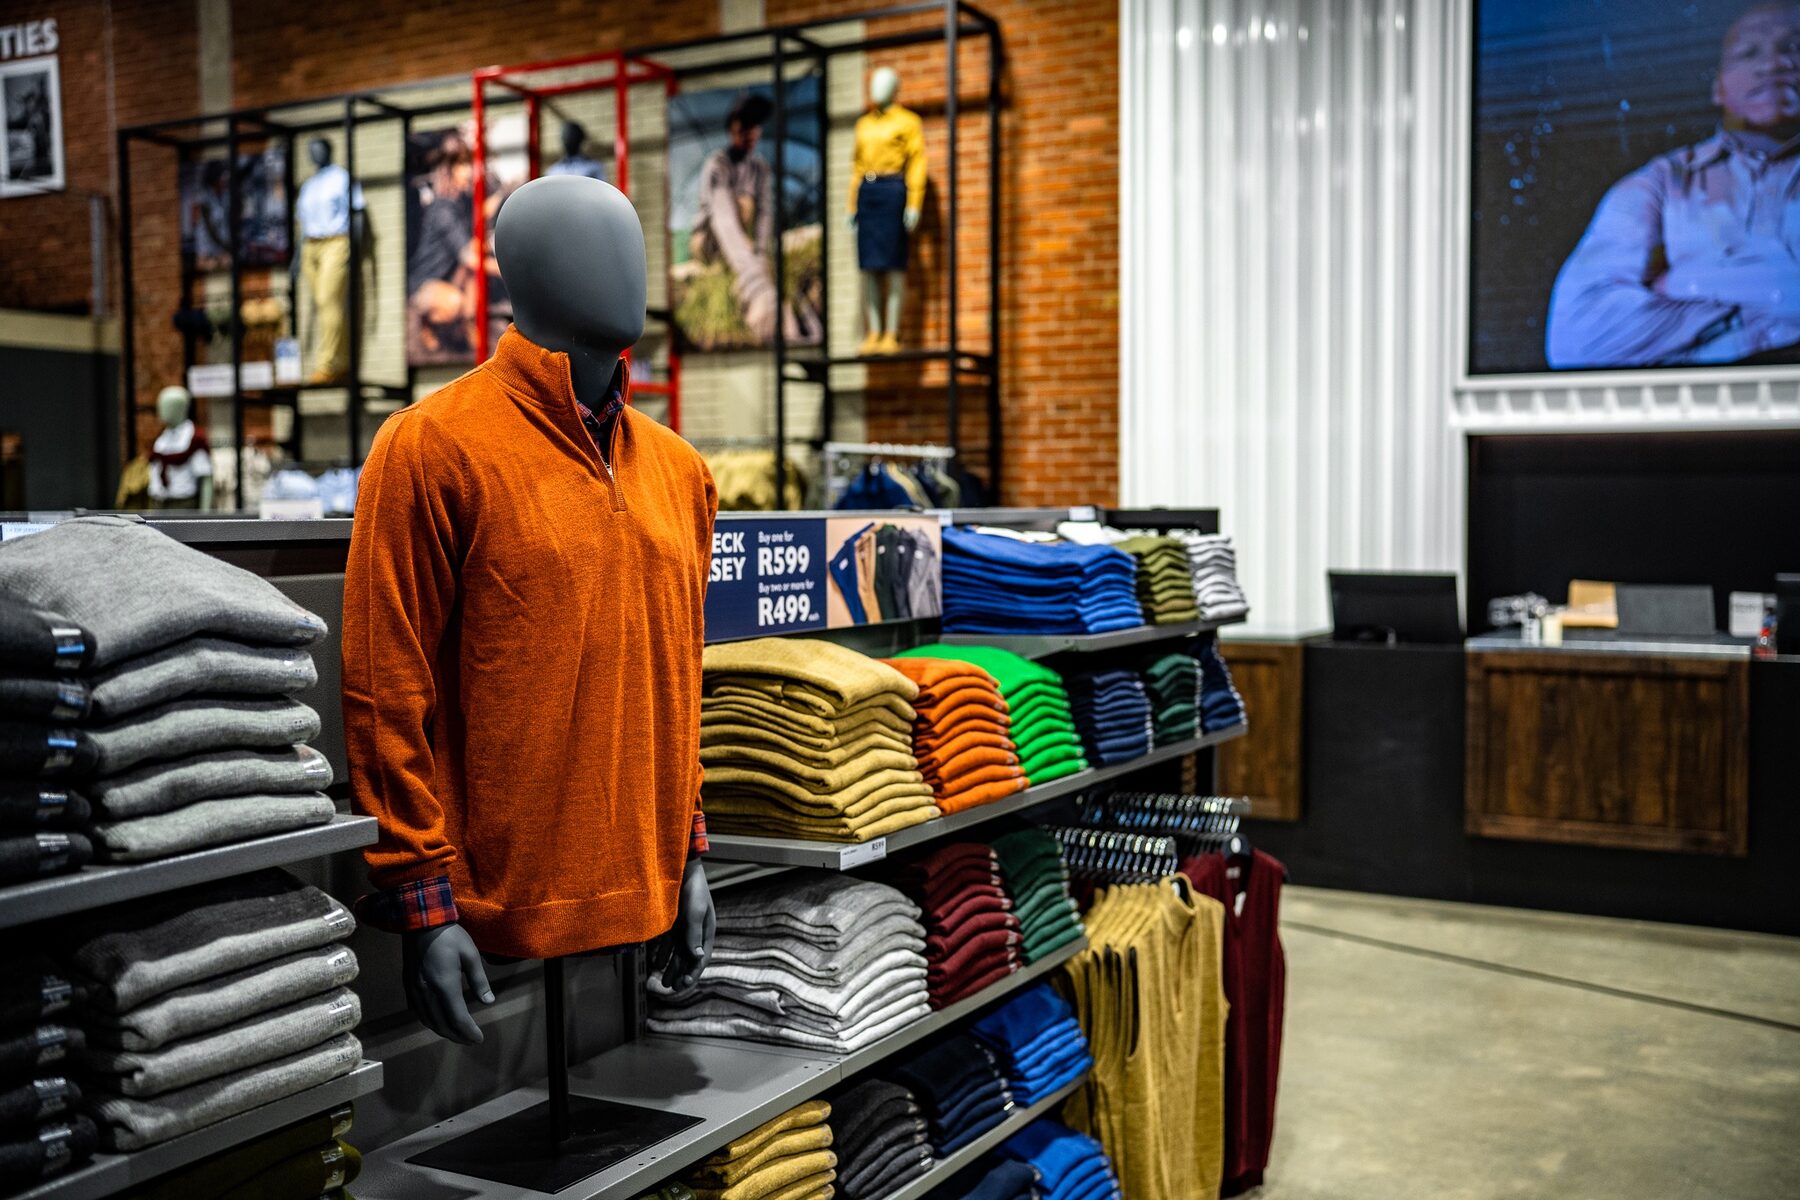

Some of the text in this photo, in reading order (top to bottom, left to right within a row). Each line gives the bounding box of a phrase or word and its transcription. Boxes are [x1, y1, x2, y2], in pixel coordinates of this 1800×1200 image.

[758, 530, 794, 545] Buy one for
[708, 556, 747, 582] SEY
[758, 544, 810, 576] R599
[758, 582, 769, 595] Buy
[783, 583, 790, 591] or
[805, 579, 815, 590] for
[758, 593, 810, 626] R499
